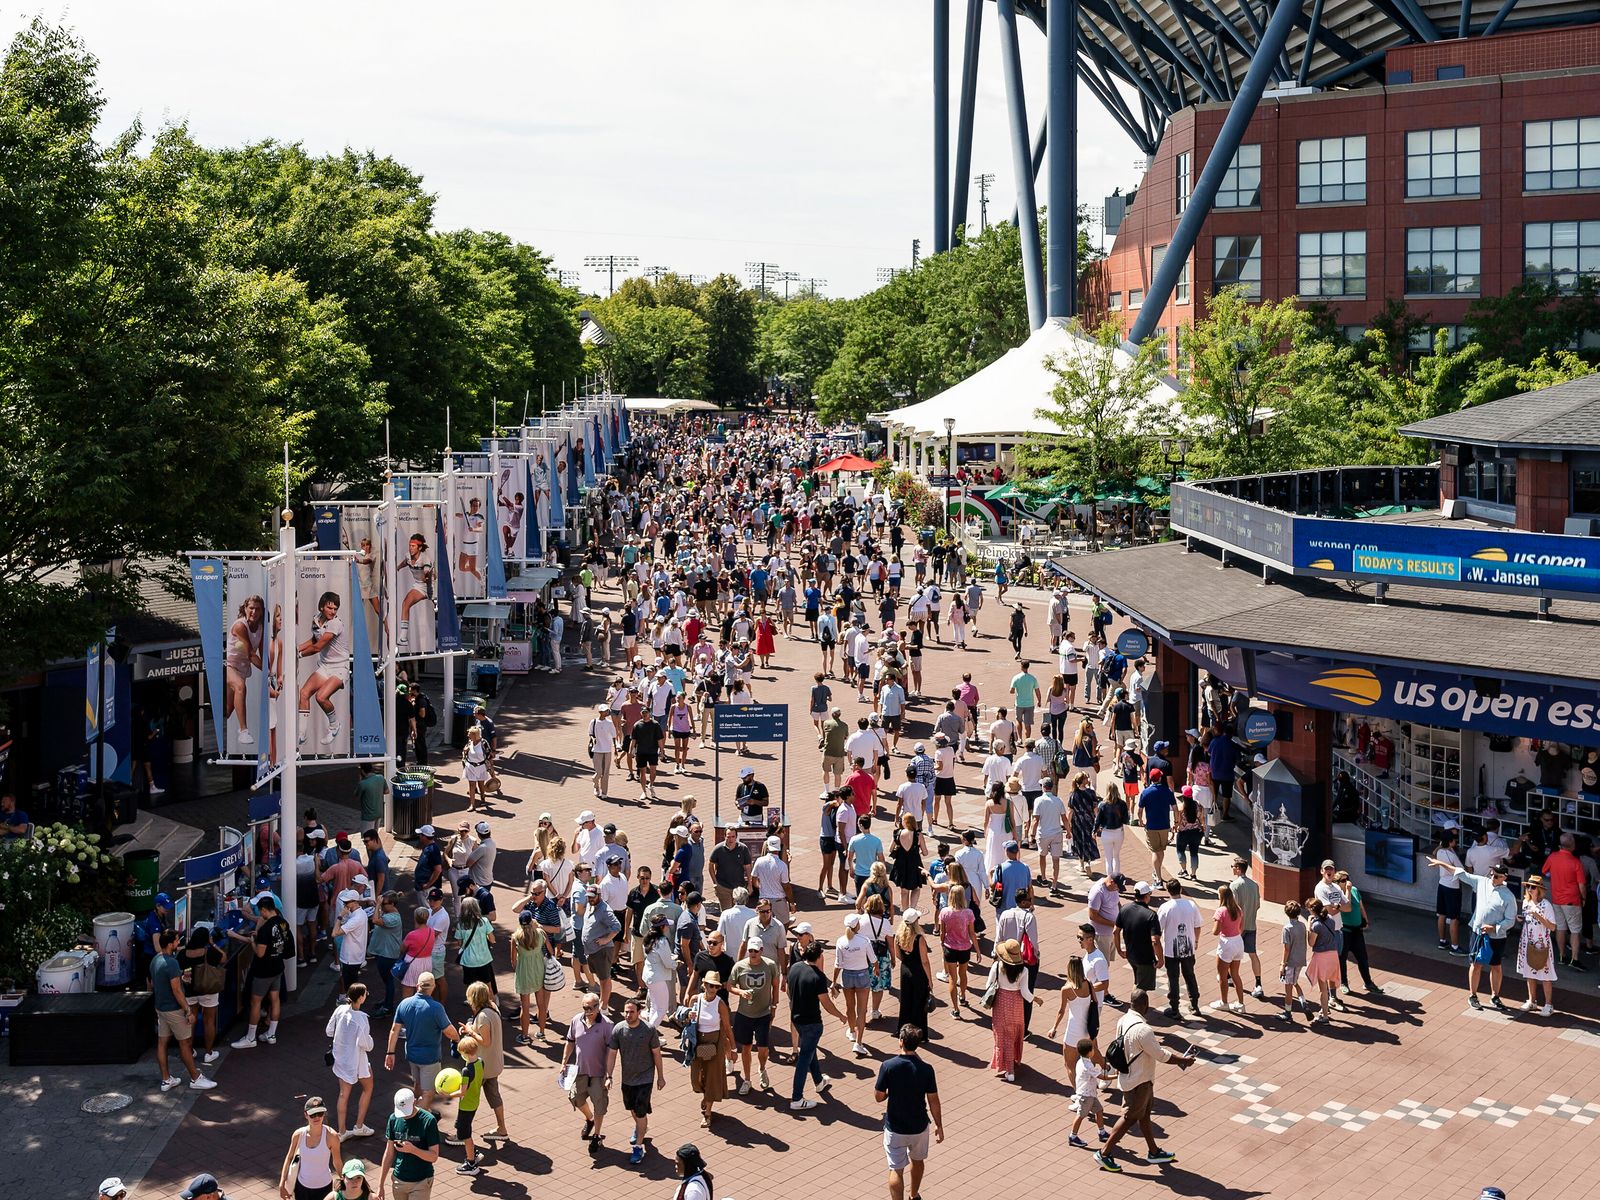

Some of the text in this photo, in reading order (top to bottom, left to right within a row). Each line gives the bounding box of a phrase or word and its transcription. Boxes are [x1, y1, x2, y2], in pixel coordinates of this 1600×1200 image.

[1359, 555, 1456, 576] TODAY'S RESULTS
[1492, 568, 1540, 586] Jansen
[147, 663, 200, 678] AMERICAN
[1393, 680, 1437, 708] us
[1441, 686, 1539, 722] open
[220, 853, 237, 868] GREY
[126, 887, 152, 897] eken
